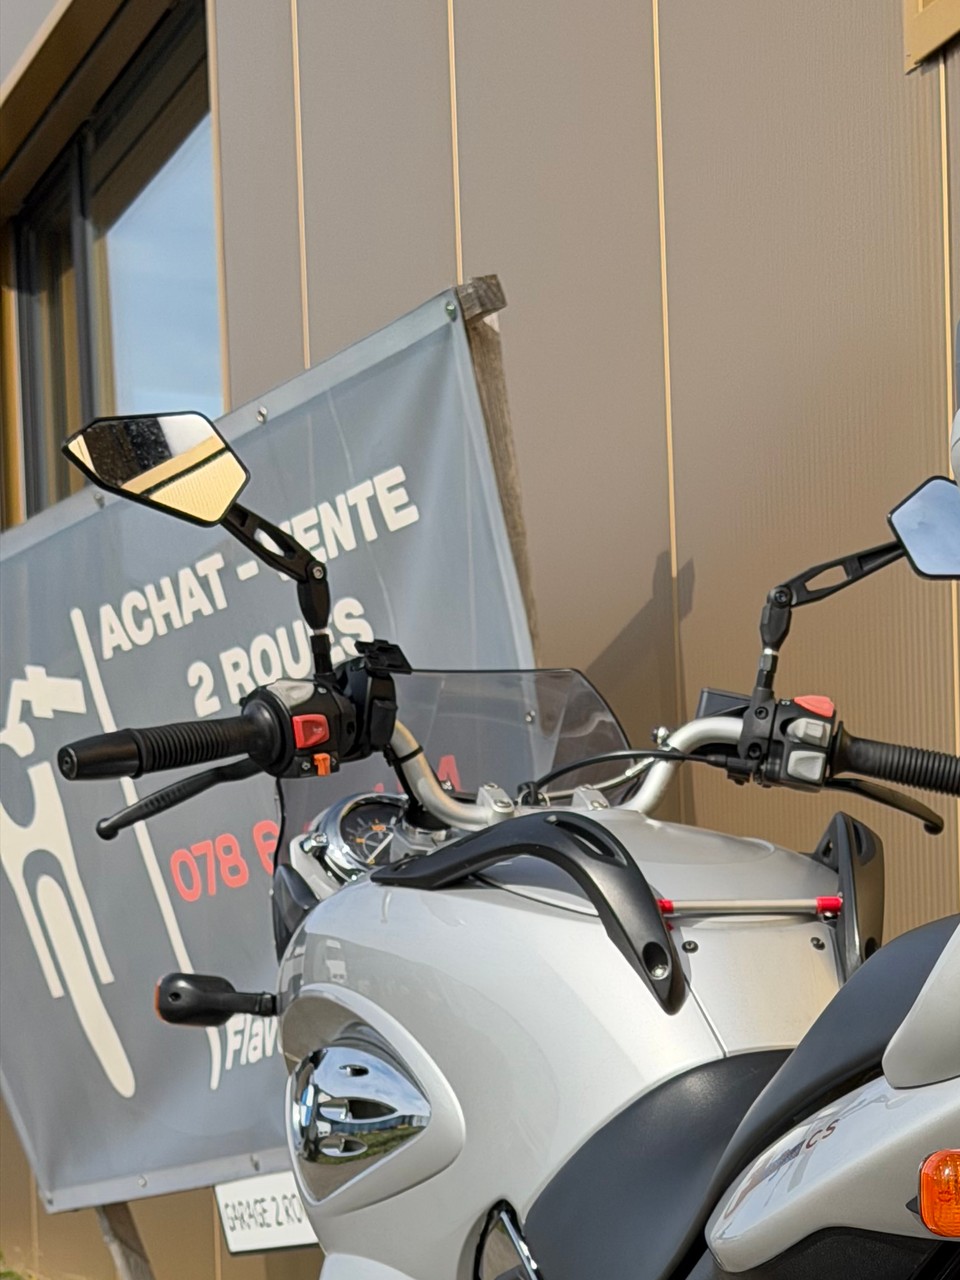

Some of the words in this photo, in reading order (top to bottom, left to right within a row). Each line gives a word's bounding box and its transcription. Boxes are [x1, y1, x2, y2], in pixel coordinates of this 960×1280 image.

[99, 553, 227, 661] ACHAT
[187, 661, 221, 718] 2
[170, 833, 249, 902] 078
[225, 1012, 283, 1070] Flav
[224, 1198, 272, 1232] GARAGE
[271, 1195, 284, 1226] 2
